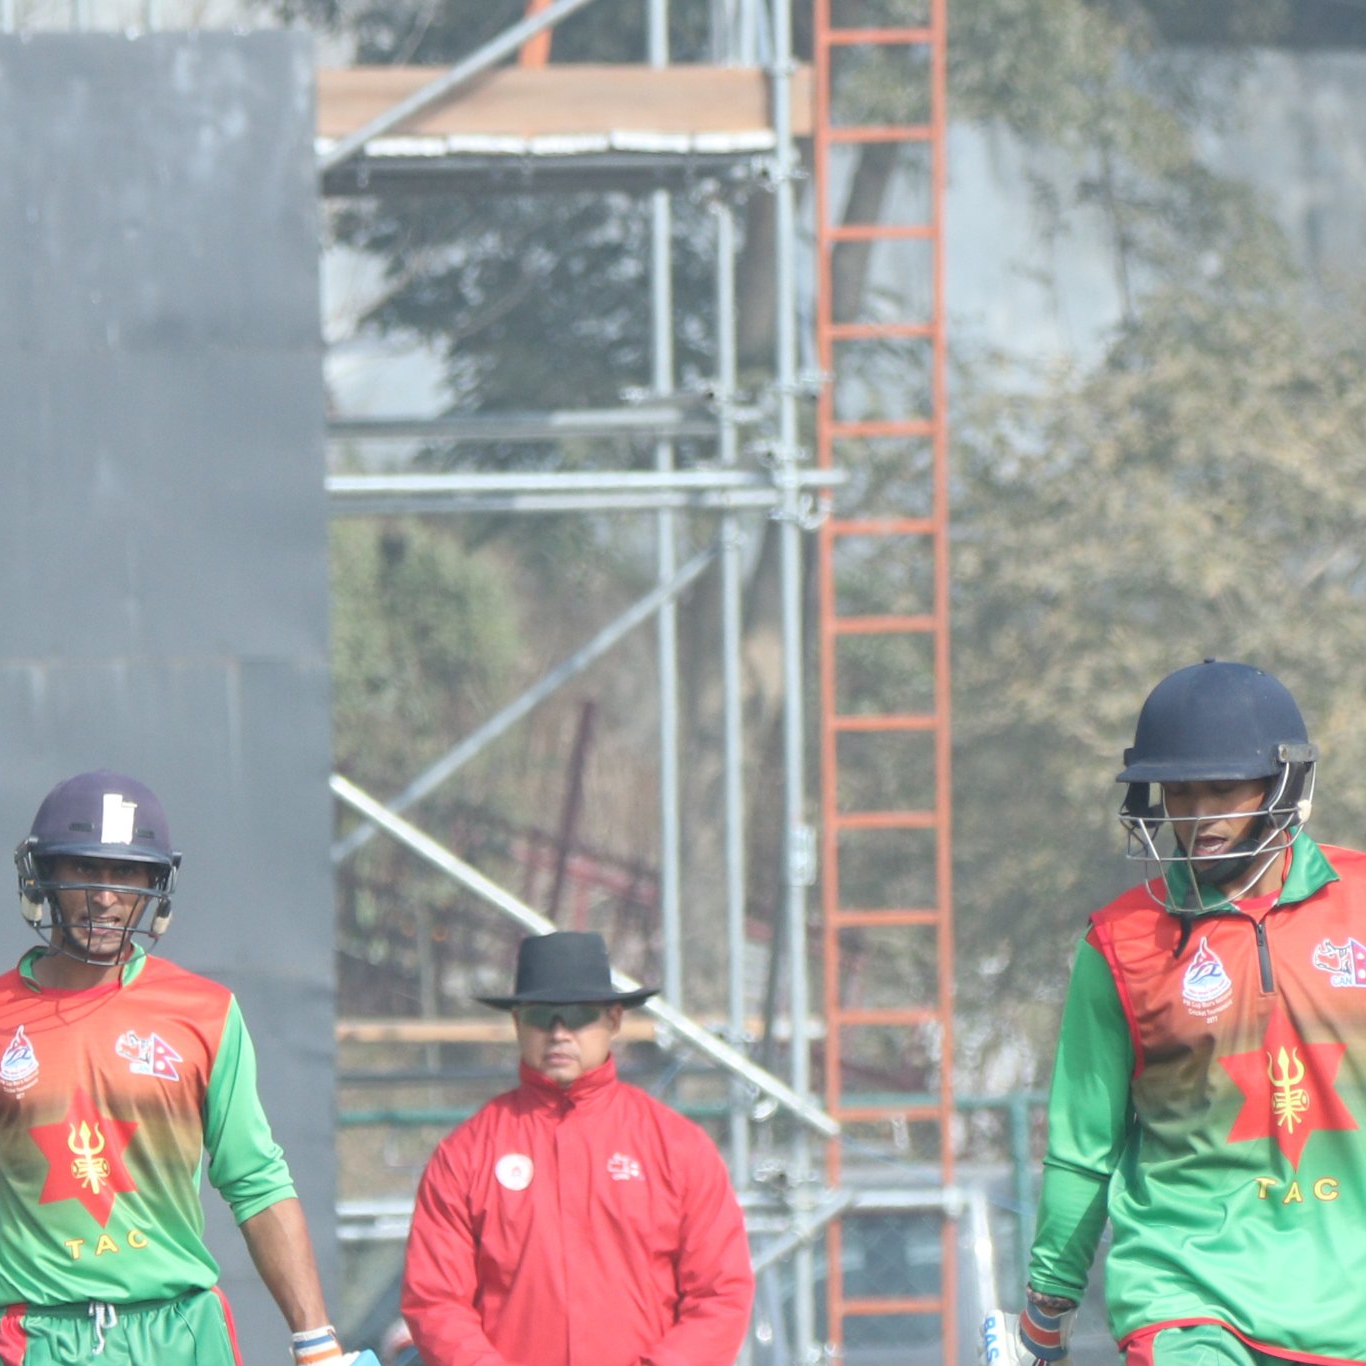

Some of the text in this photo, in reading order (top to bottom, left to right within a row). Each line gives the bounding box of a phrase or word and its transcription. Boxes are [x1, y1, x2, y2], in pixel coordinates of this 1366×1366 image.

[1253, 1176, 1339, 1205] TAC
[65, 1229, 148, 1260] TAC
[984, 1315, 999, 1362] BAS
